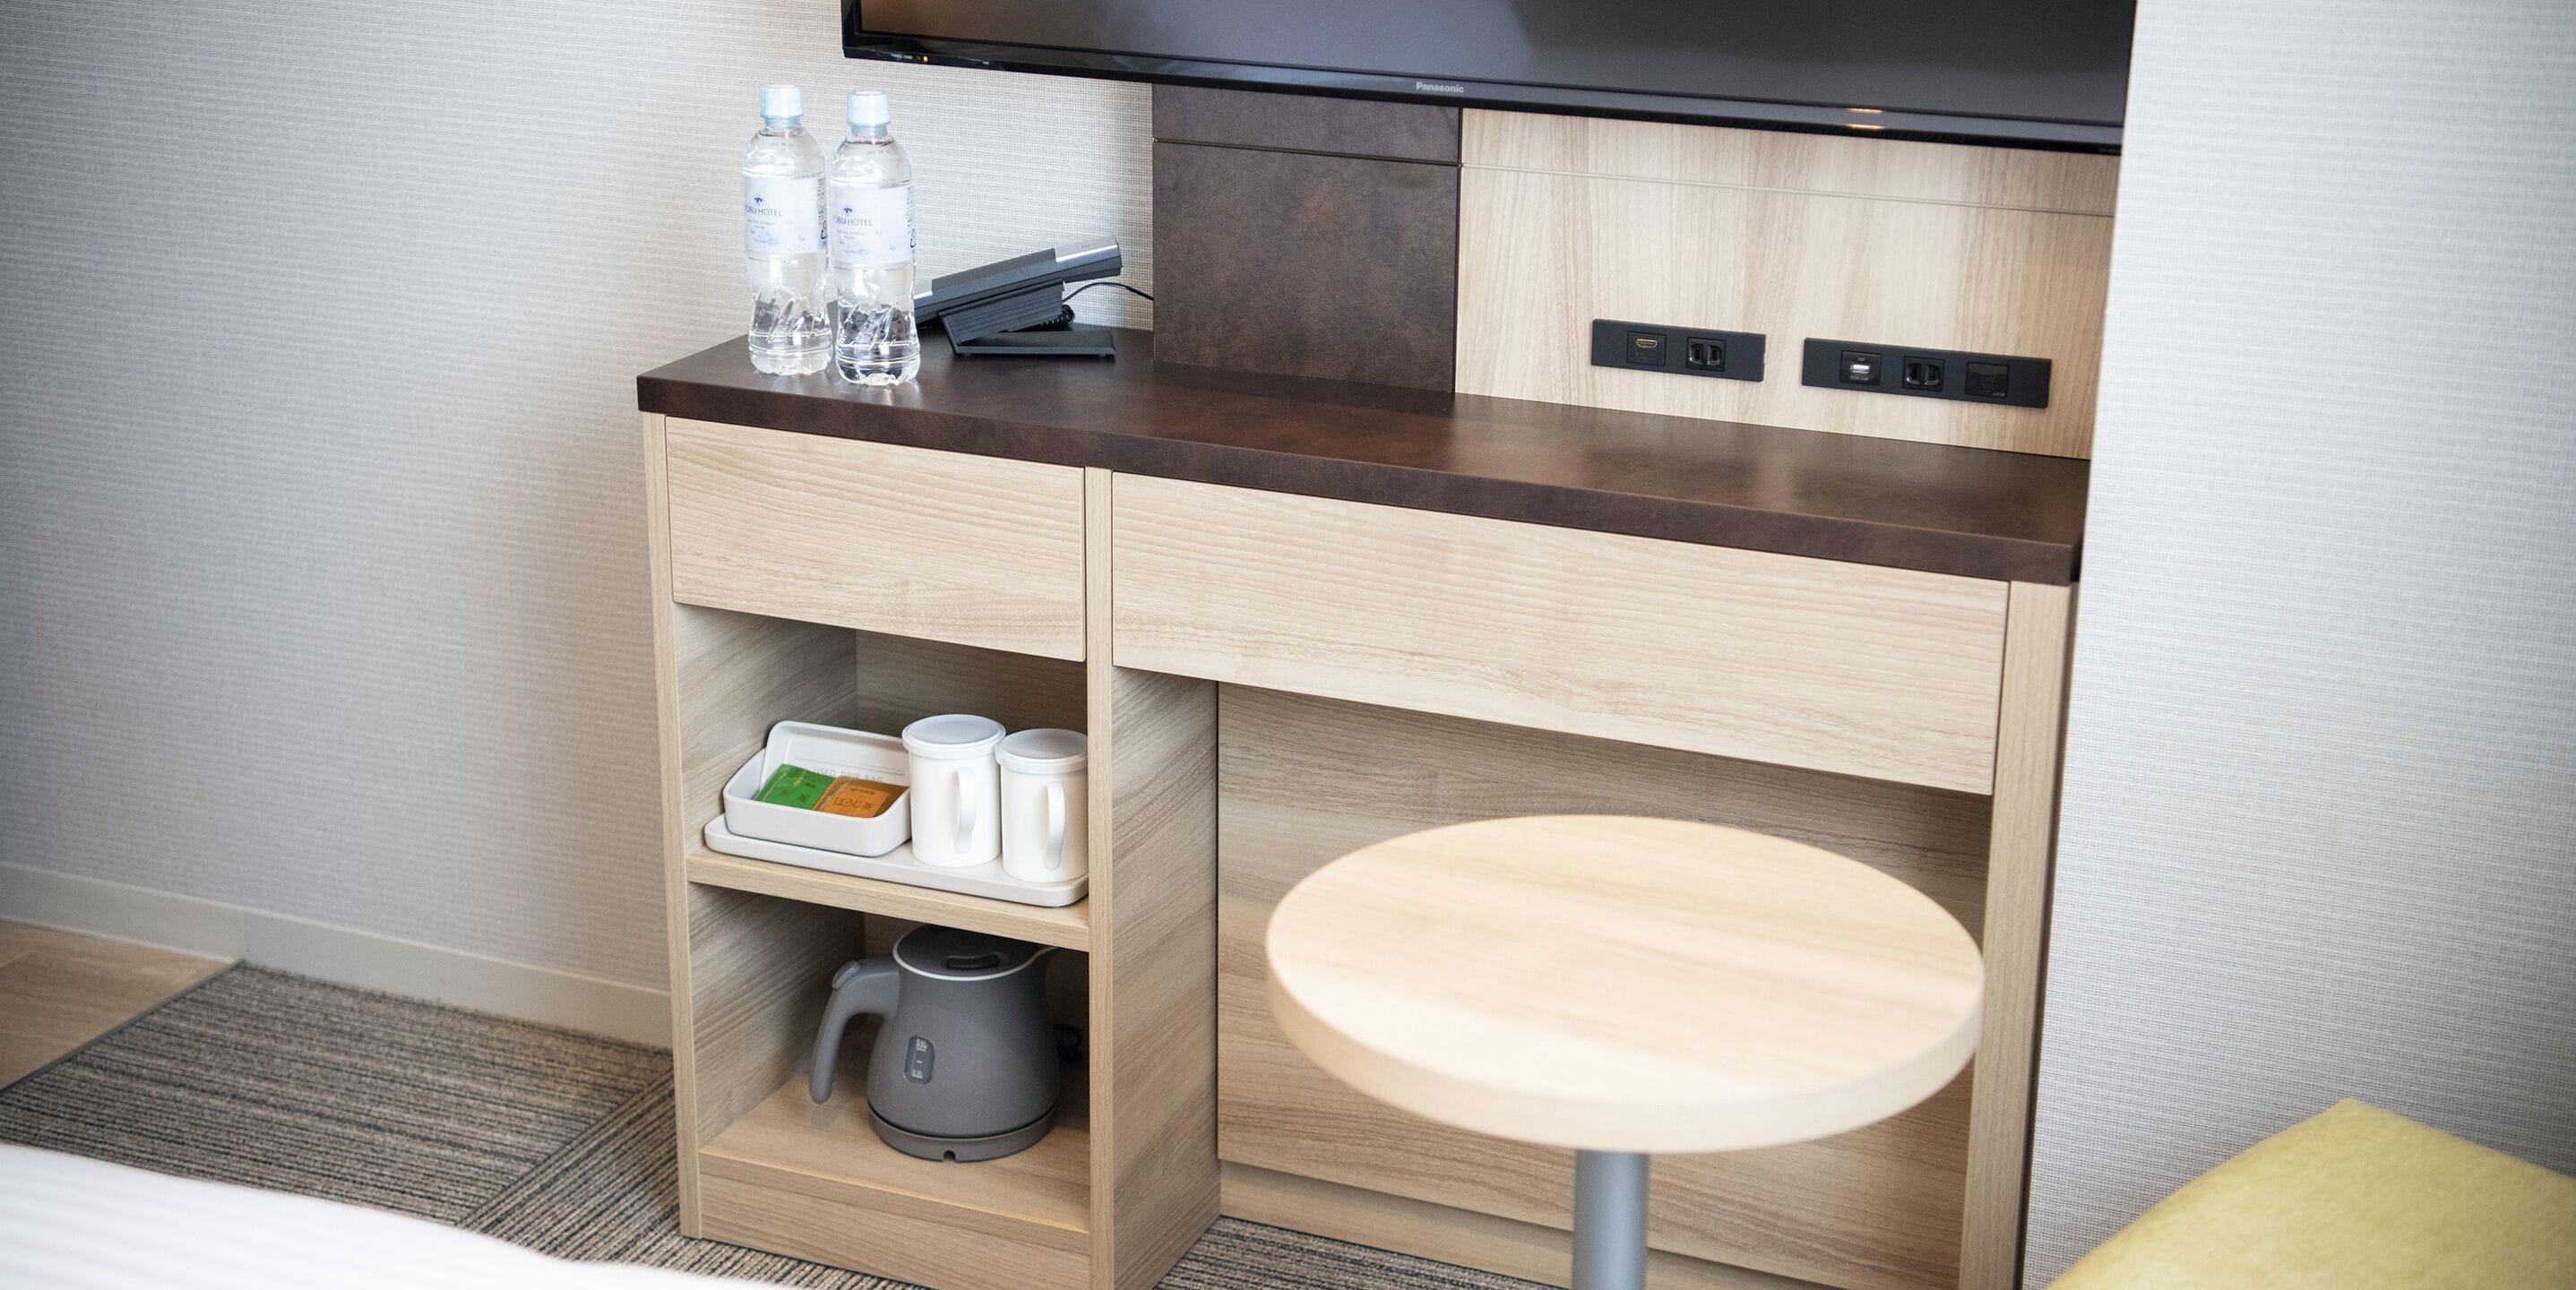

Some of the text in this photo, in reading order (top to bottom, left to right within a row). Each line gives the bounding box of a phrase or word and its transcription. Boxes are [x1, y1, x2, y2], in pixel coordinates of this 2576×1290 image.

[1416, 82, 1465, 93] Panasonic
[758, 207, 783, 217] HOTEL
[847, 218, 873, 227] HOTEL
[833, 796, 875, 811] ほうじ茶
